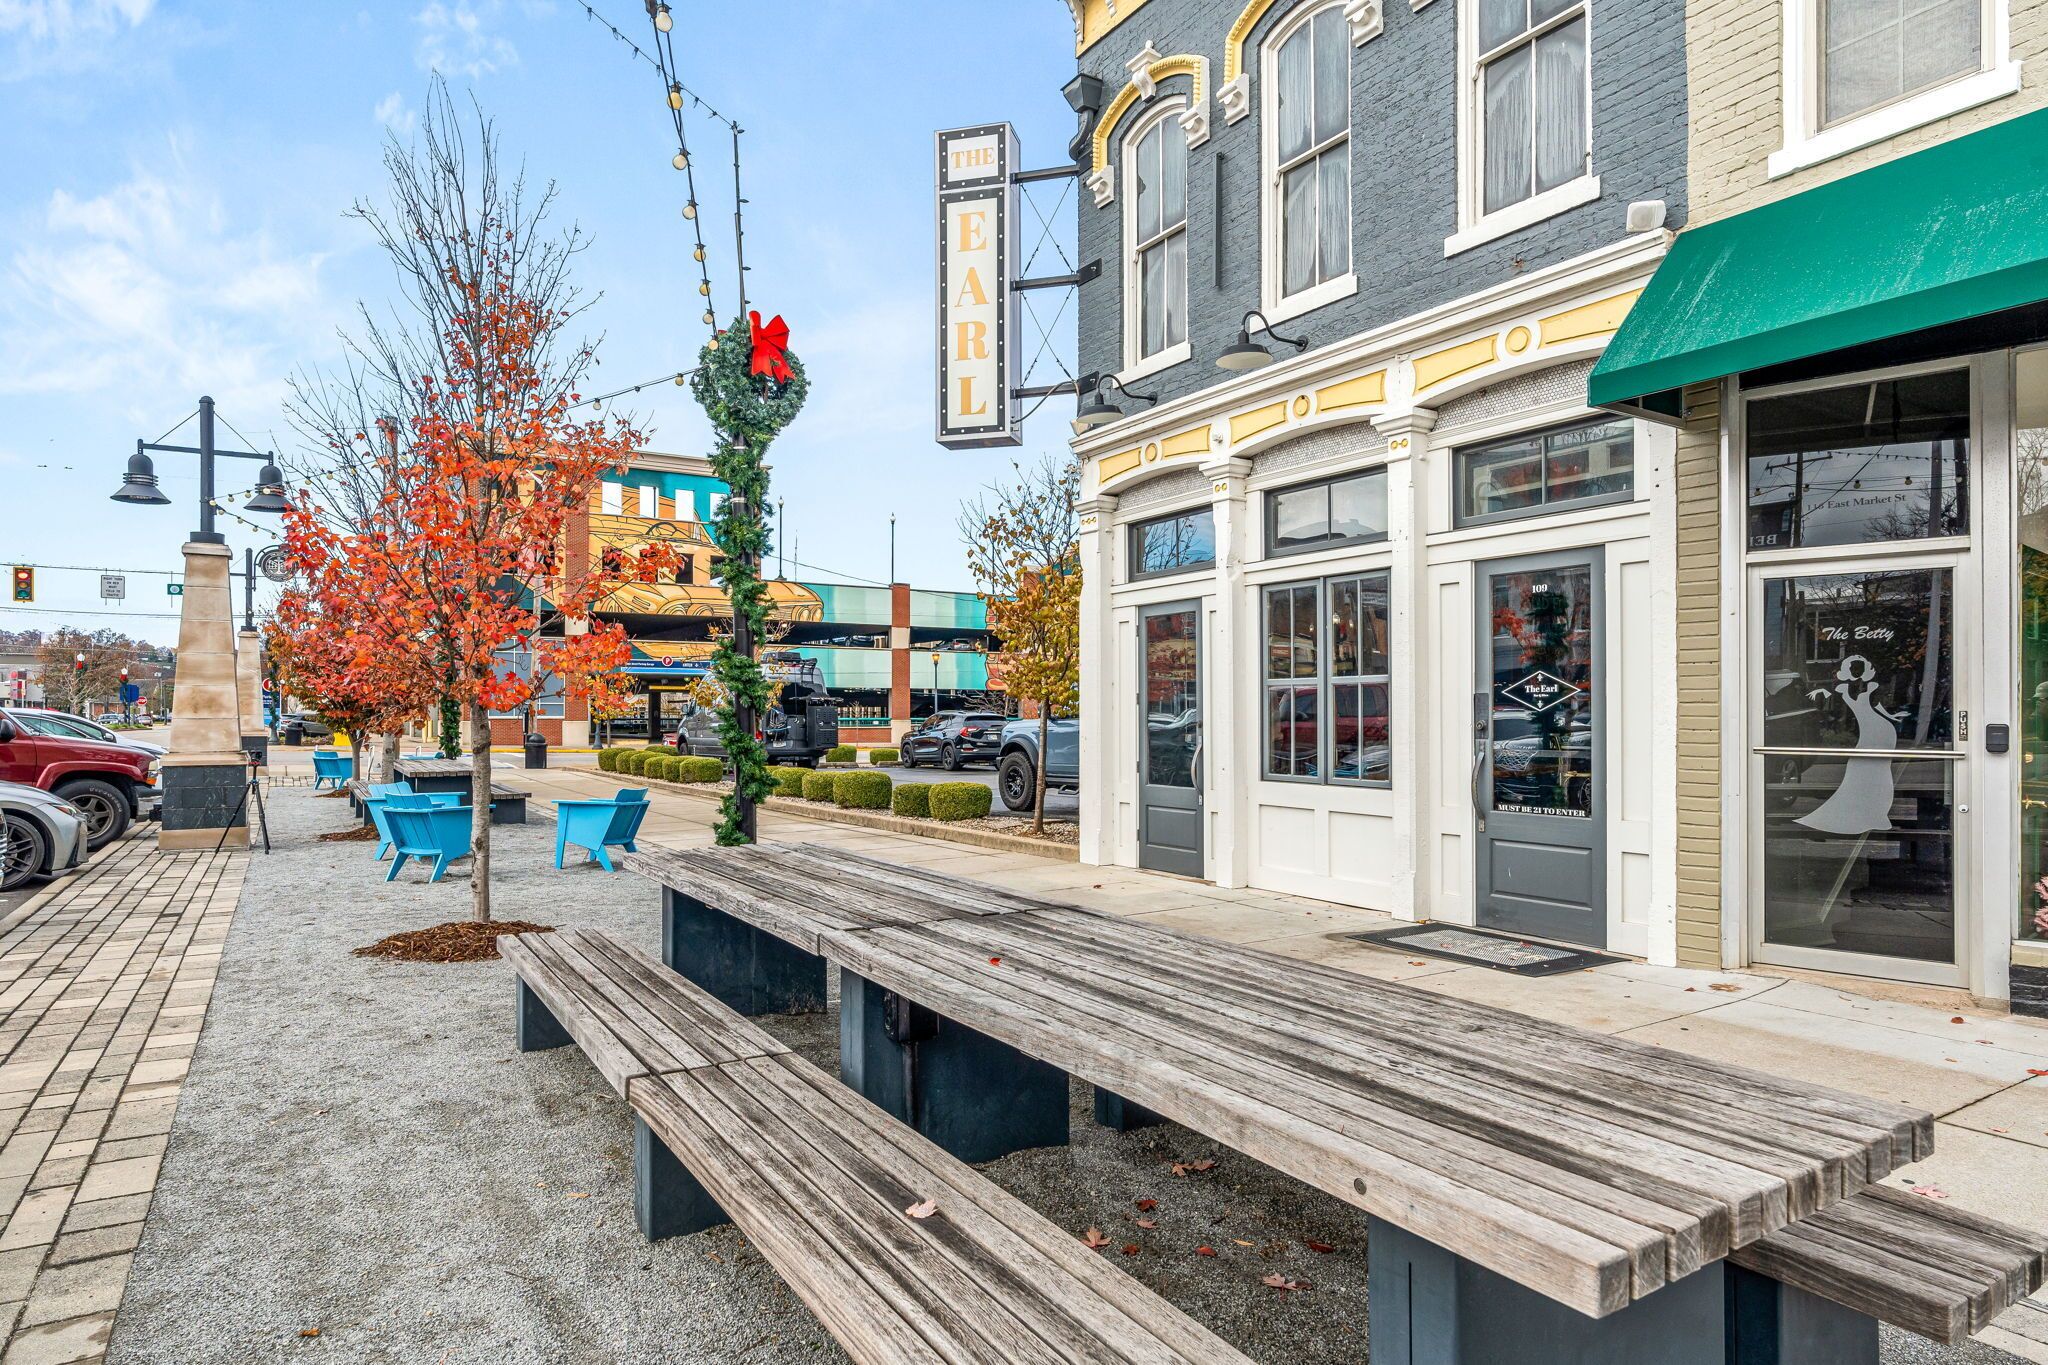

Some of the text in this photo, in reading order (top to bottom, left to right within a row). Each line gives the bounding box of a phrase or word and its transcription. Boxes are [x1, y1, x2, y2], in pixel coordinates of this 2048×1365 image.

[951, 147, 995, 169] THE
[955, 211, 990, 416] EARL
[1828, 499, 1850, 509] East
[1853, 496, 1892, 506] Market
[1894, 493, 1906, 502] St
[1532, 584, 1548, 593] 109
[1822, 625, 1894, 642] The Betty
[665, 657, 671, 665] P
[1525, 684, 1559, 693] The Earl
[1498, 804, 1520, 812] MUST
[1543, 807, 1555, 815] TO
[1556, 808, 1586, 817] ENTER
